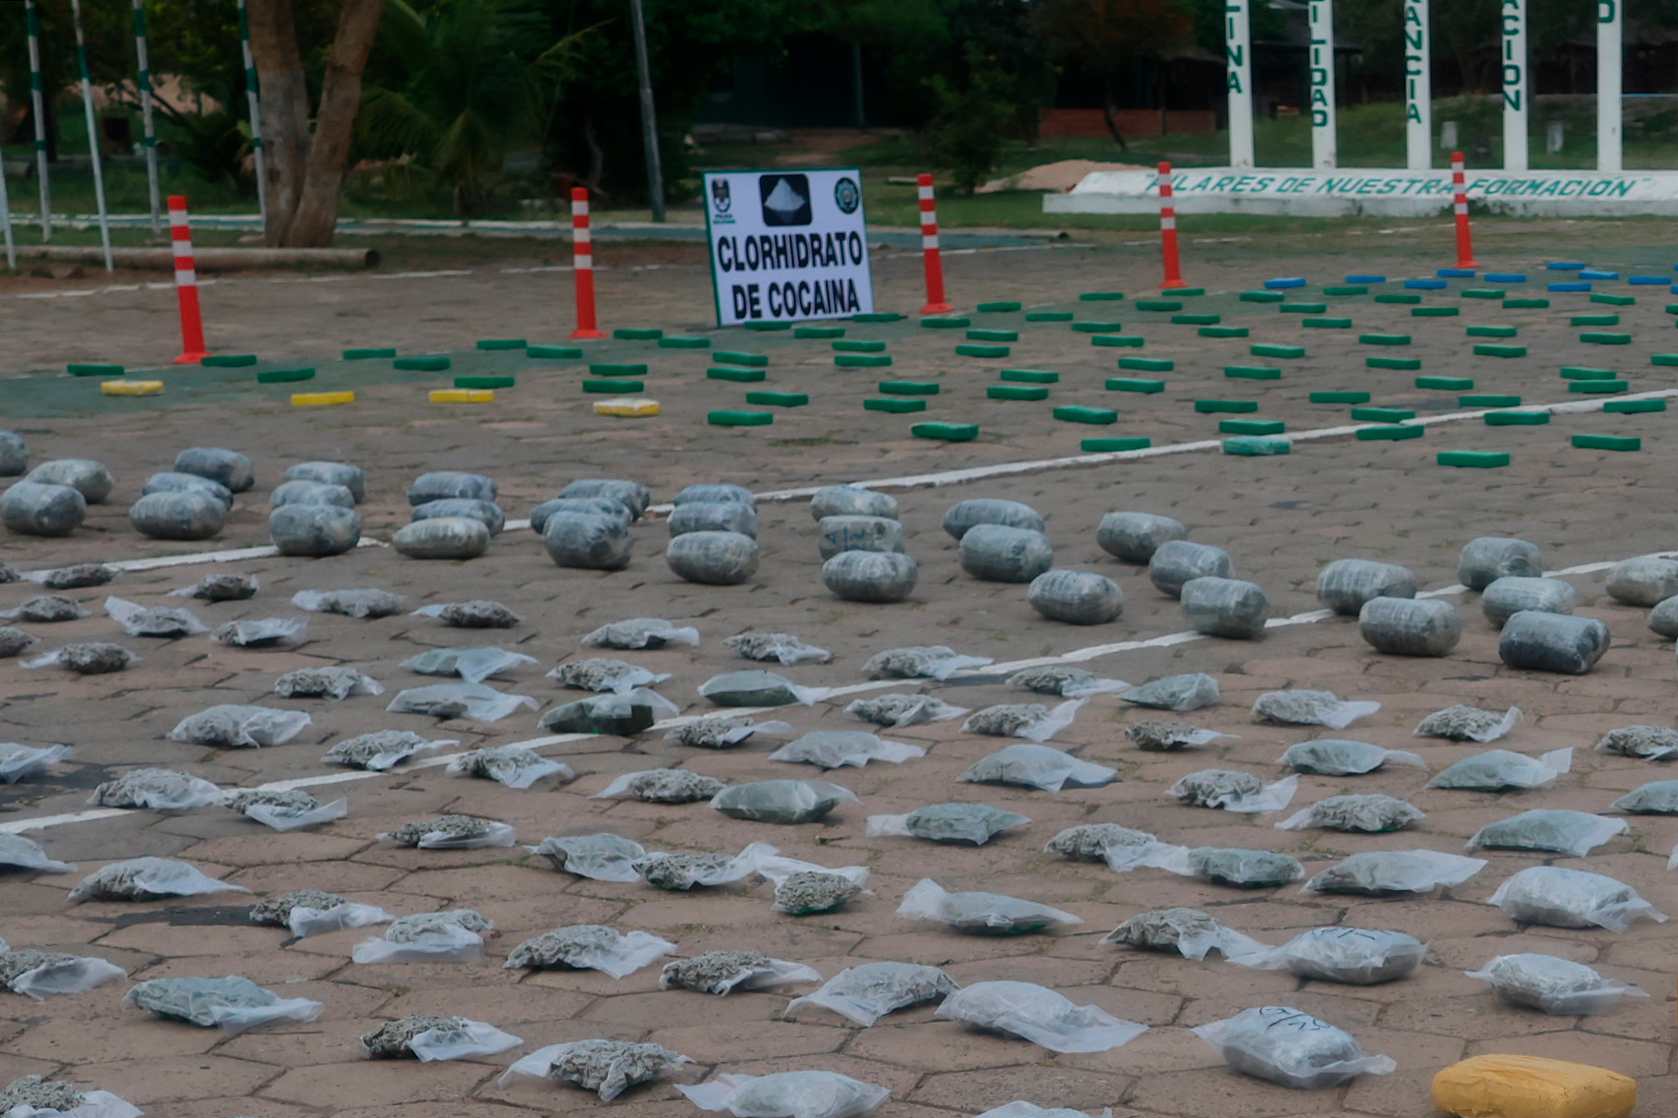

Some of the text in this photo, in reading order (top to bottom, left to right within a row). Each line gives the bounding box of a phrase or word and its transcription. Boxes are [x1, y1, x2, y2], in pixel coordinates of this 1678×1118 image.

[1310, 0, 1328, 127] ILIDAD
[1404, 0, 1423, 124] ANCIA
[1275, 176, 1317, 192] DE
[1316, 177, 1455, 194] NUESTRA
[717, 231, 863, 272] CLORHIDRATO
[732, 278, 860, 320] DE COCAINA
